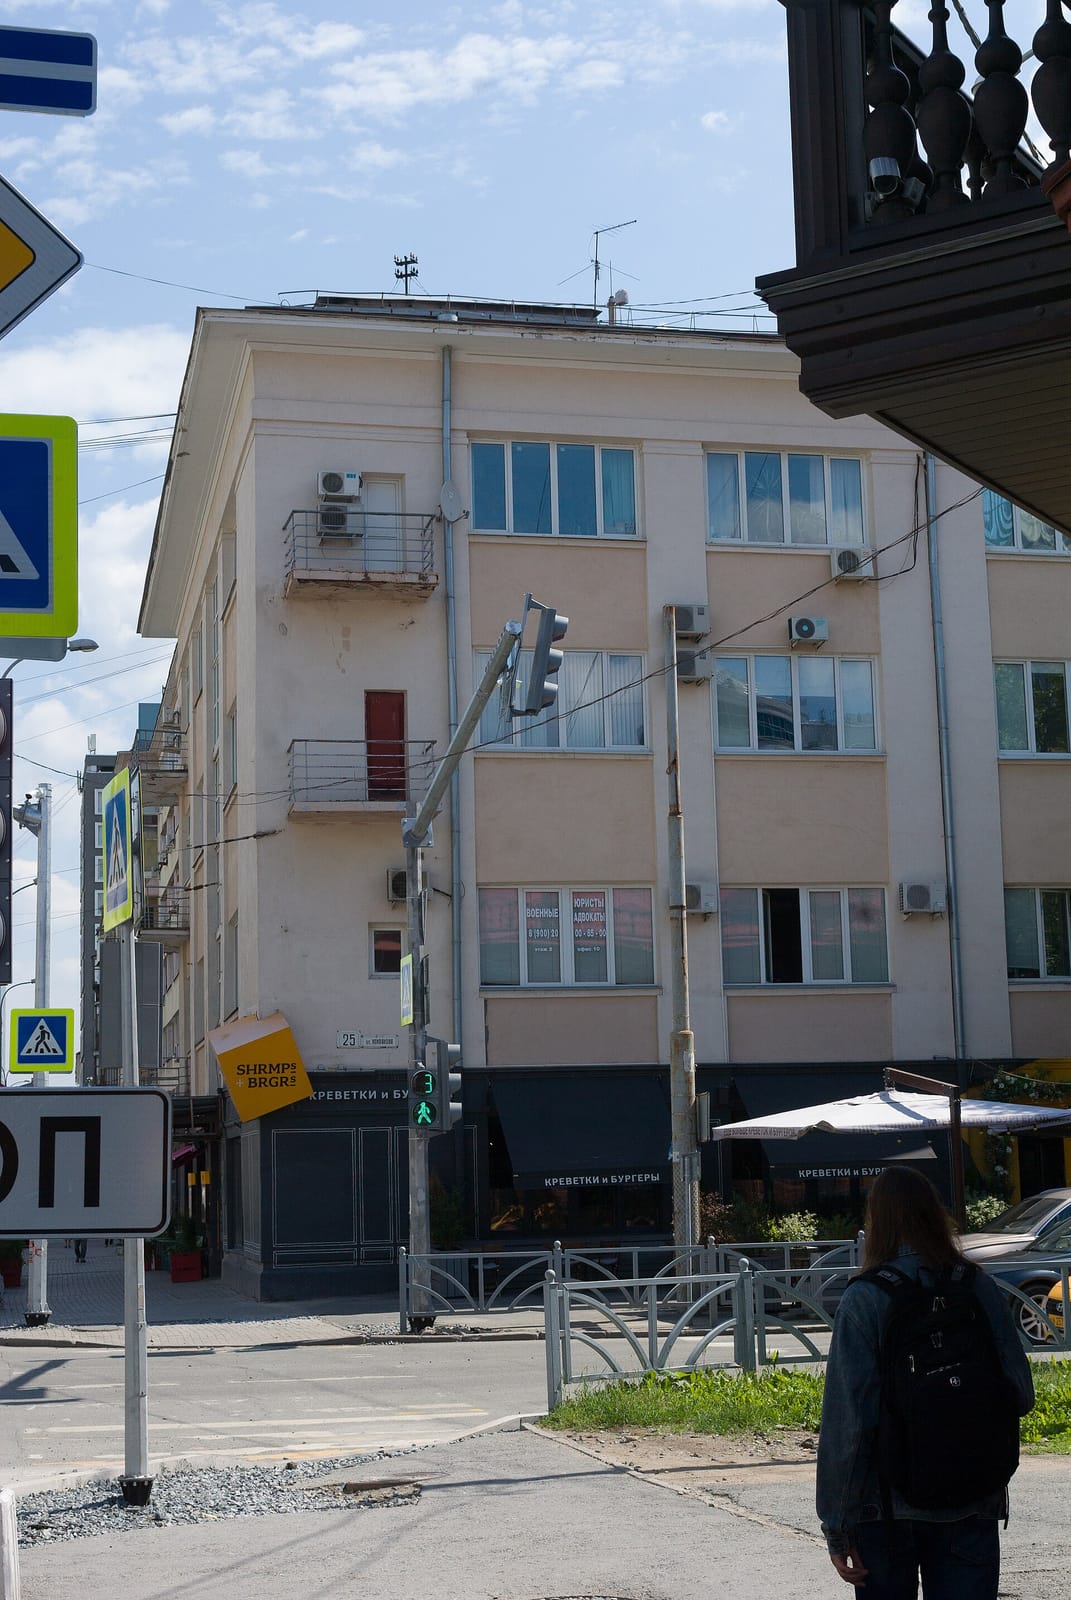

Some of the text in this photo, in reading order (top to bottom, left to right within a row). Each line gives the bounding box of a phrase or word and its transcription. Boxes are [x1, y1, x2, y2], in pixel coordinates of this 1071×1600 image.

[574, 898, 604, 908] ЮРИСТЫ
[526, 908, 559, 918] ВОЕННЫЕ
[574, 912, 606, 923] АДВОКАТЫ
[342, 1033, 356, 1046] 25
[424, 1073, 433, 1094] 3
[309, 1089, 377, 1101] КРЕВЕТКИ
[798, 1168, 851, 1178] КРЕВЕТКИ
[544, 1175, 600, 1188] КРЕВЕТКИ
[610, 1173, 661, 1185] БУРГЕРЫ
